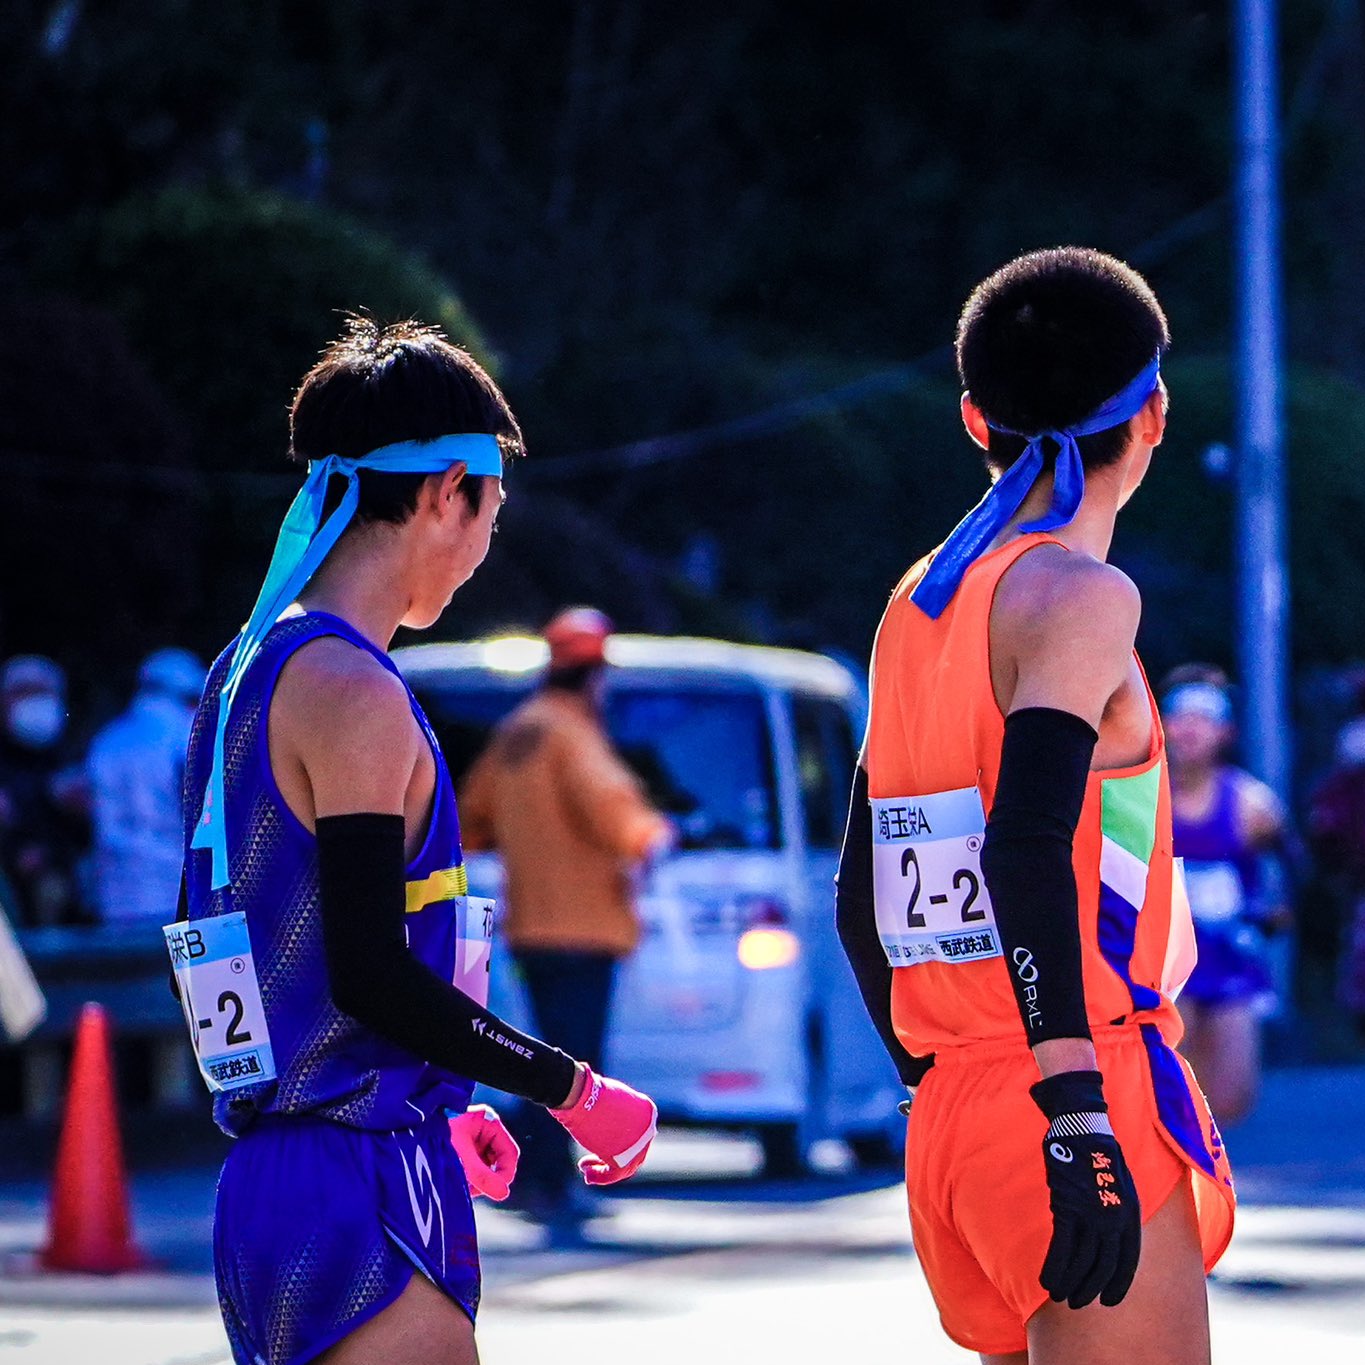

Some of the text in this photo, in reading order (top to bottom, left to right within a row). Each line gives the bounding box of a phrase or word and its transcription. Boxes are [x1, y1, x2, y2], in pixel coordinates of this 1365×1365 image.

[901, 848, 986, 928] 2-2
[939, 934, 994, 956] 西武鉄道
[209, 1054, 260, 1081] 西武鉄道
